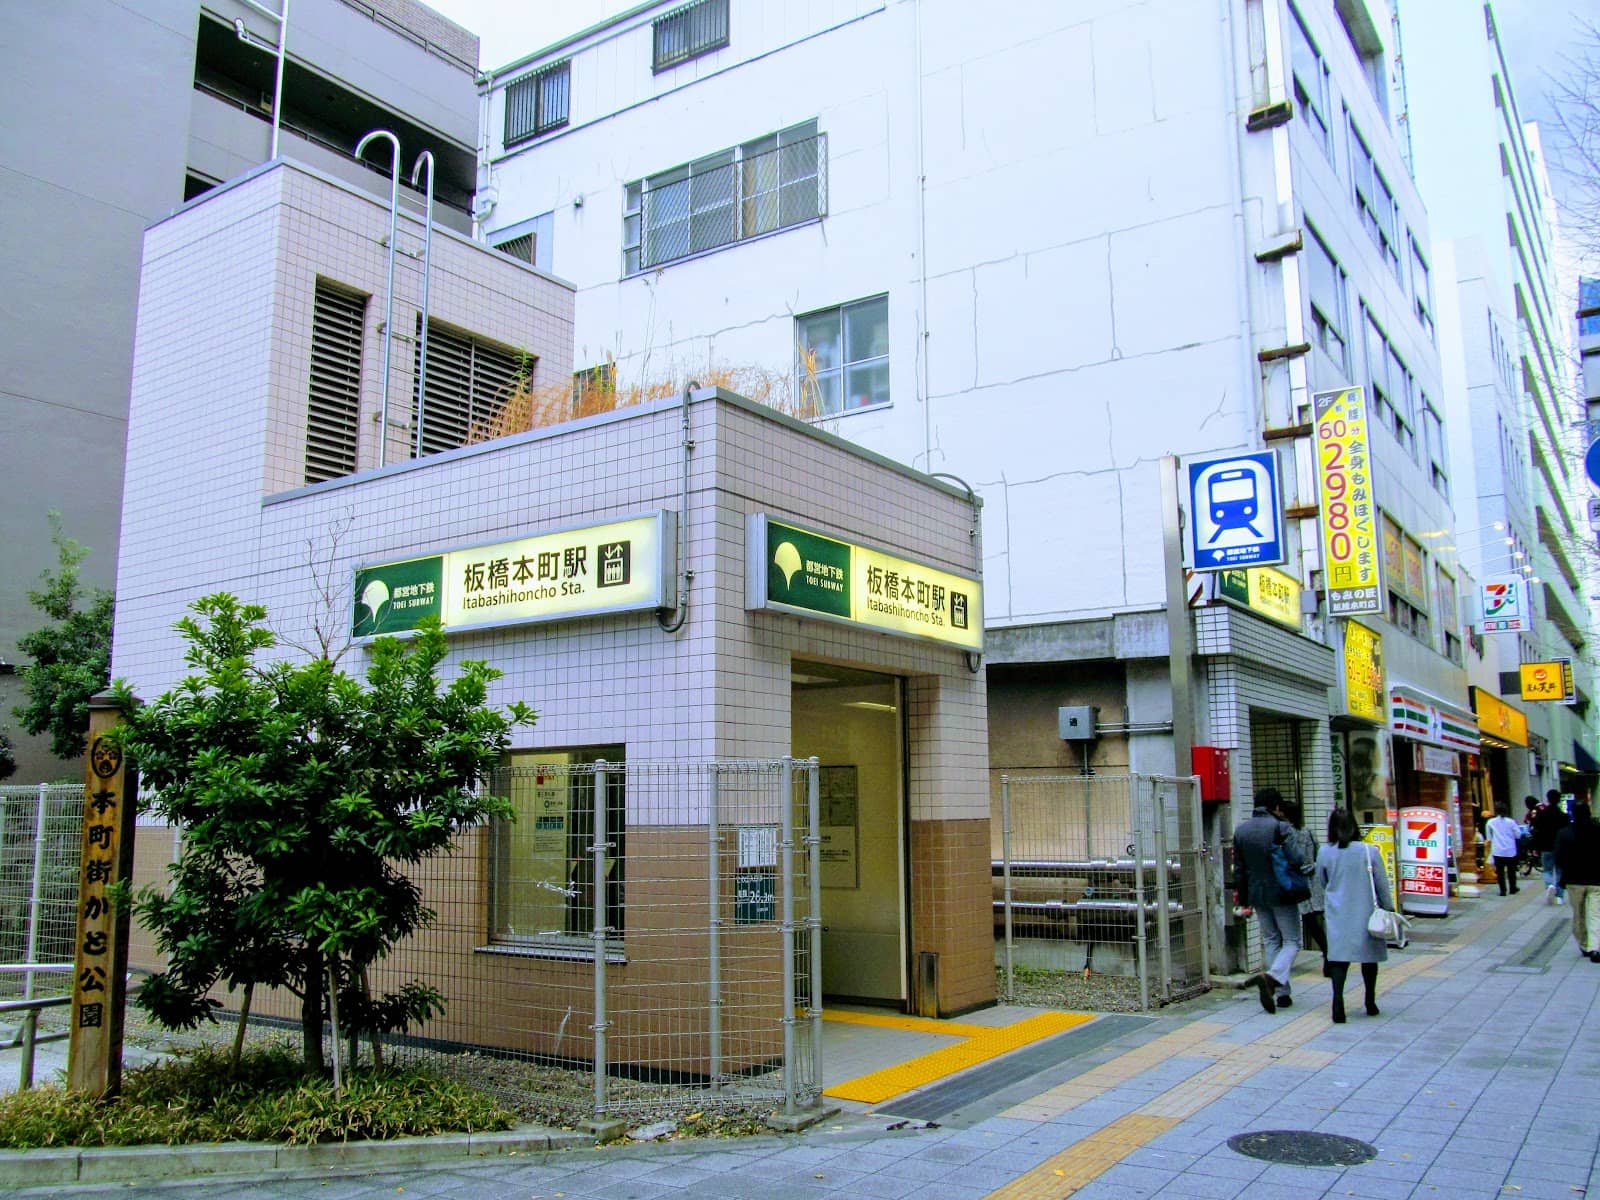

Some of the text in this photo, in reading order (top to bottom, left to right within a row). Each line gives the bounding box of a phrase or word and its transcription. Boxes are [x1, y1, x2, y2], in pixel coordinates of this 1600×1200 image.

[464, 545, 588, 593] 板橋本町駅
[806, 559, 844, 580] 都営地下鉄
[392, 582, 435, 598] 都営地下鉄
[463, 581, 585, 609] Itabashihoncho Sta.
[806, 576, 844, 592] TOEI SUBWAY
[867, 565, 946, 613] 板橋本町駅
[393, 597, 434, 610] TOEI SUBWAY
[867, 596, 945, 626] Itabashihoncho Sta.
[1407, 821, 1437, 858] 7
[1416, 866, 1444, 880] たばこ
